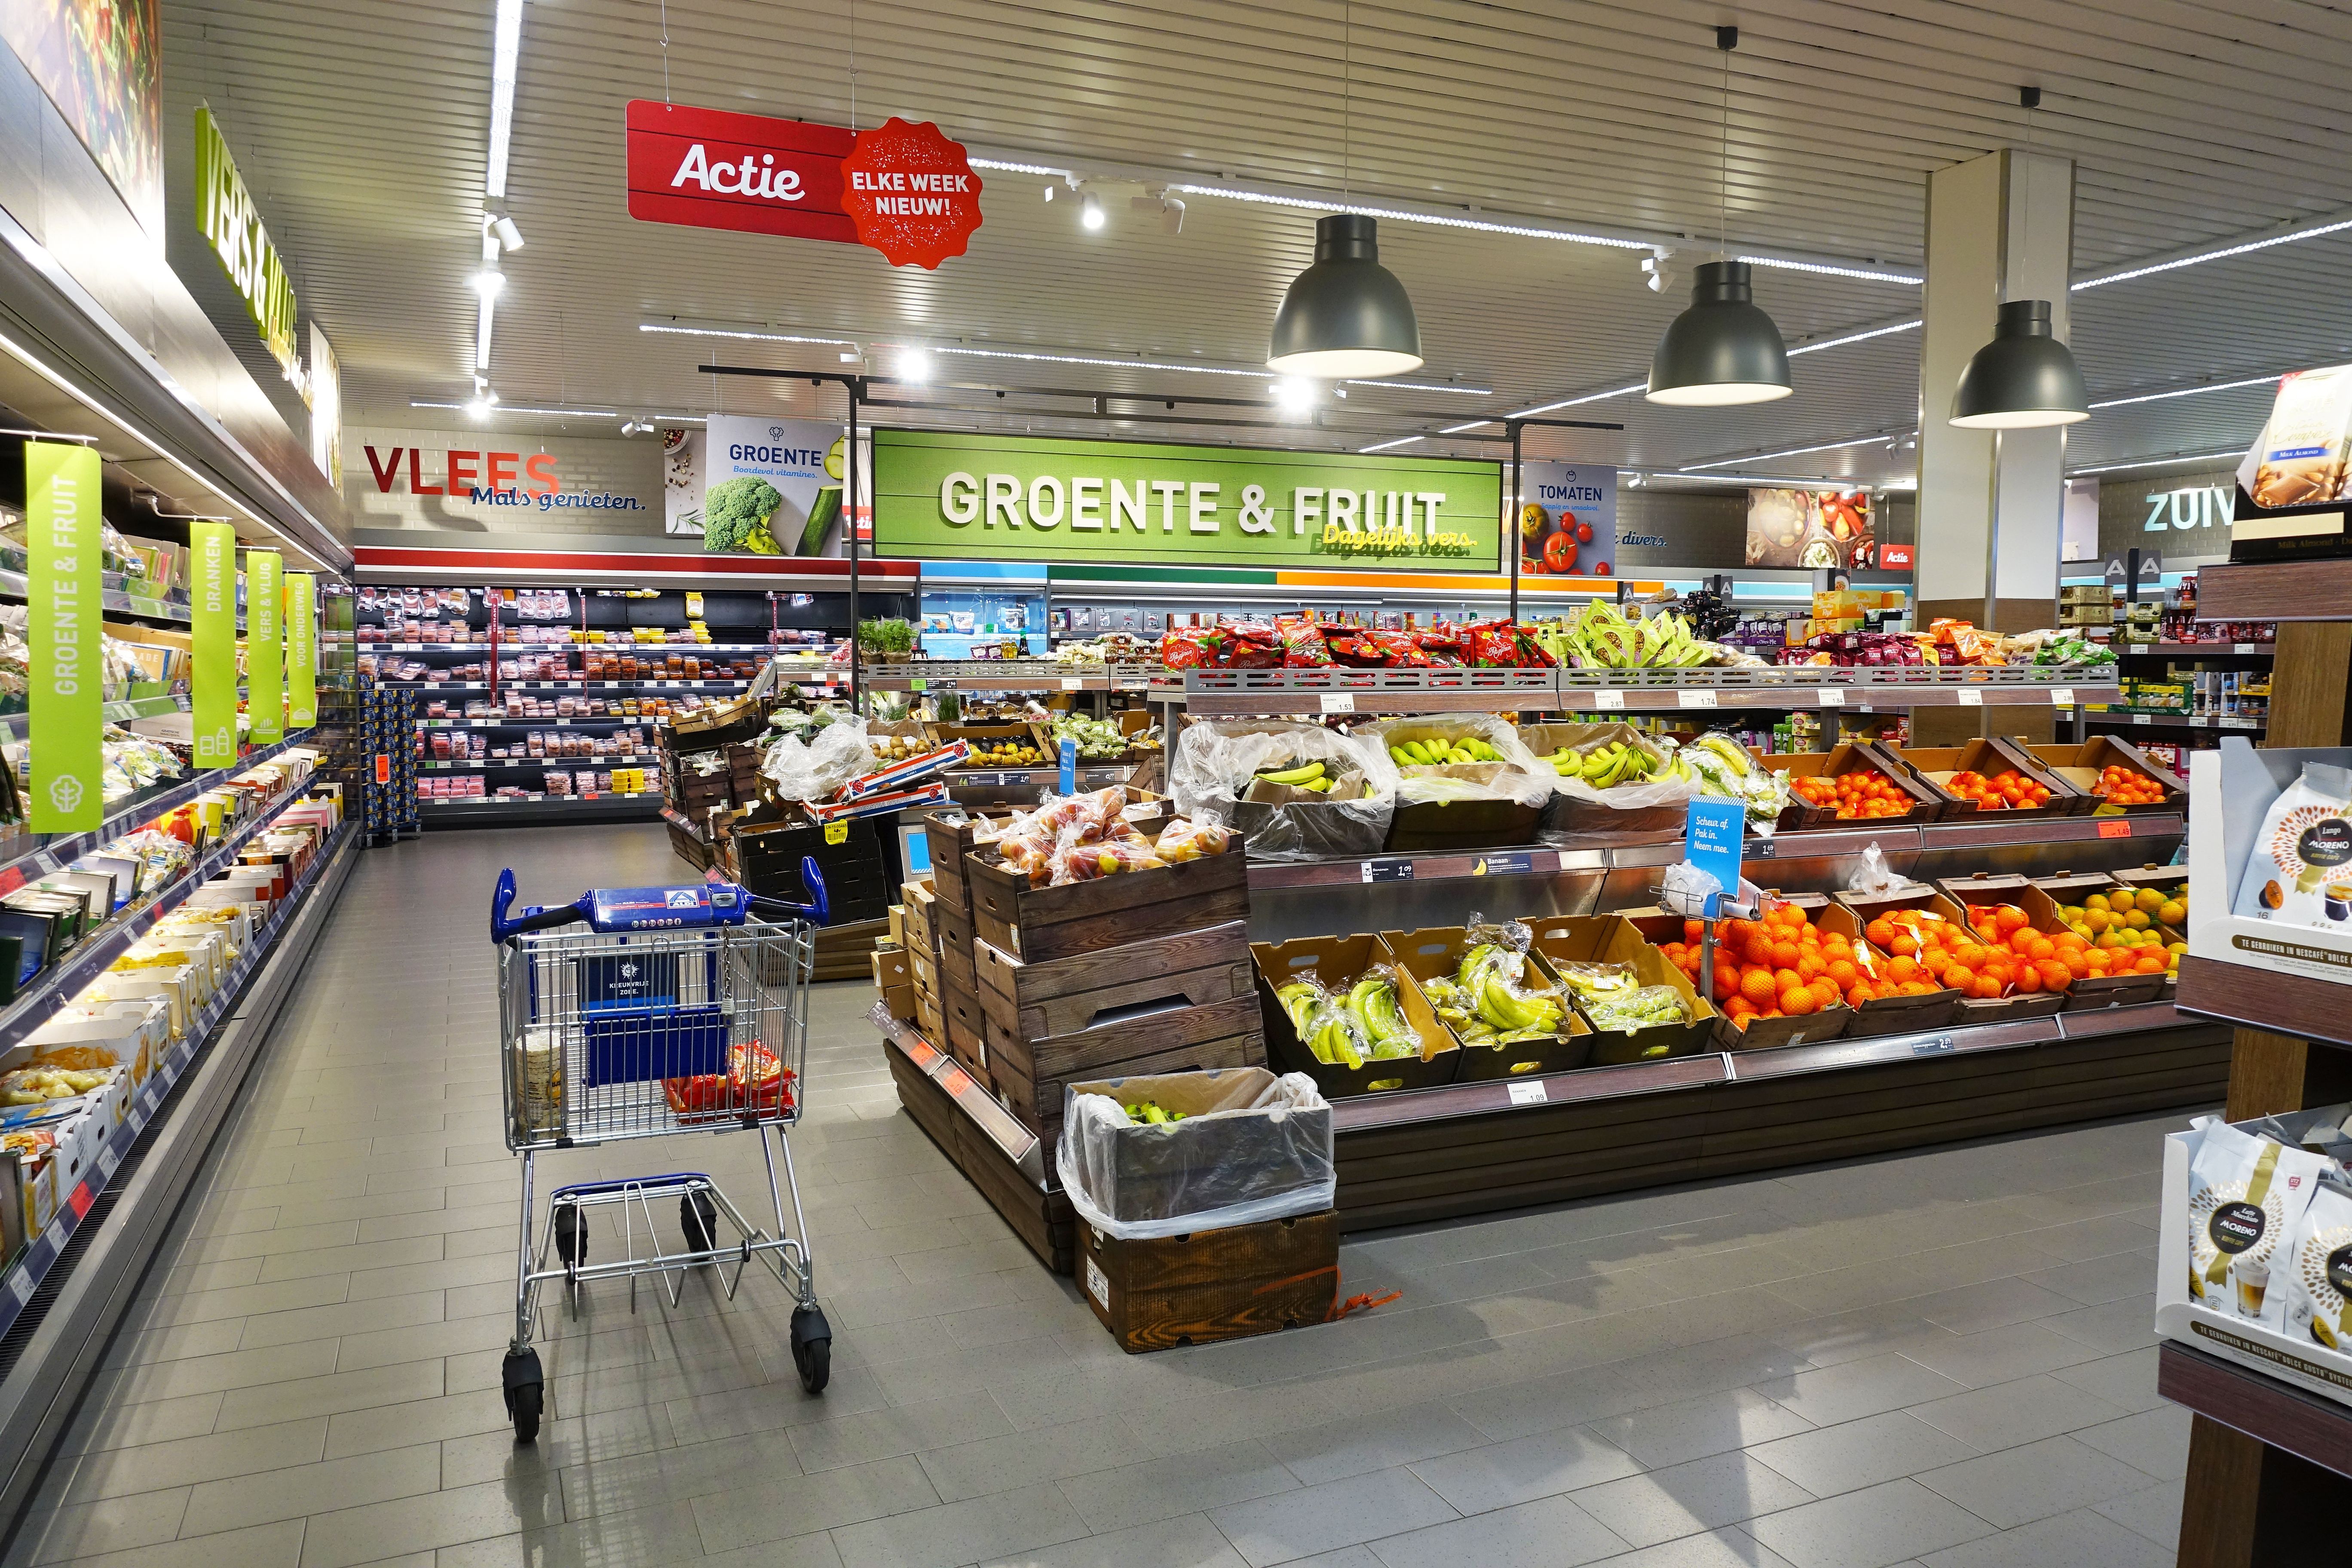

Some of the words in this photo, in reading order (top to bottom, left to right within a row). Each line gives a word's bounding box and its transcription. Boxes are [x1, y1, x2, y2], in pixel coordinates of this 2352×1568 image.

[671, 144, 805, 201] Actie
[853, 172, 905, 191] ELKE
[910, 174, 970, 193] WEEK
[876, 197, 951, 215] NIEUW!
[730, 444, 822, 467] GROENTE
[363, 446, 559, 500] VLEES
[733, 466, 774, 475] Boordevol
[776, 469, 818, 478] vitamines.
[472, 486, 531, 506] Mals
[539, 490, 646, 511] genieten.
[1539, 485, 1602, 502] TOMATEN
[53, 474, 77, 547] FRUIT
[941, 472, 1220, 532] GROENTE
[1238, 484, 1277, 533] &
[1294, 487, 1446, 537] FRUIT
[1323, 524, 1422, 551] Dagelijks
[1427, 530, 1478, 546] vers.
[1622, 530, 1667, 547] divers.
[54, 555, 77, 573] &
[1886, 552, 1908, 563] Actie
[206, 536, 221, 612] DRANKEN
[259, 563, 271, 596] VLUG
[263, 597, 271, 607] &
[297, 582, 305, 638] ONDERWEG
[260, 609, 272, 642] VERS
[54, 581, 78, 695] GROENTE
[297, 639, 306, 667] VOOR
[852, 802, 885, 813] HOEKSTRA
[887, 796, 912, 805] GRAPES
[1696, 816, 1718, 827] Scheur
[1720, 819, 1728, 830] af.
[1695, 830, 1708, 838] Pak
[1709, 830, 1718, 839] in.
[1694, 841, 1711, 851] Neem
[1713, 845, 1729, 854] mee.
[1763, 845, 1773, 854] 1.69
[2308, 840, 2349, 849] MORENO
[1398, 866, 1412, 876] 1.09
[2251, 940, 2285, 953] GEBRUIKEN
[2328, 953, 2348, 964] DOLCE
[2231, 1210, 2258, 1223] Macchiato
[2242, 1208, 2256, 1216] Latte
[2220, 1220, 2257, 1236] MORENO
[2201, 1326, 2207, 1335] TE
[2209, 1328, 2241, 1347] GEBRUIKEN
[2243, 1340, 2250, 1350] IN
[2282, 1356, 2301, 1369] DOLCE
